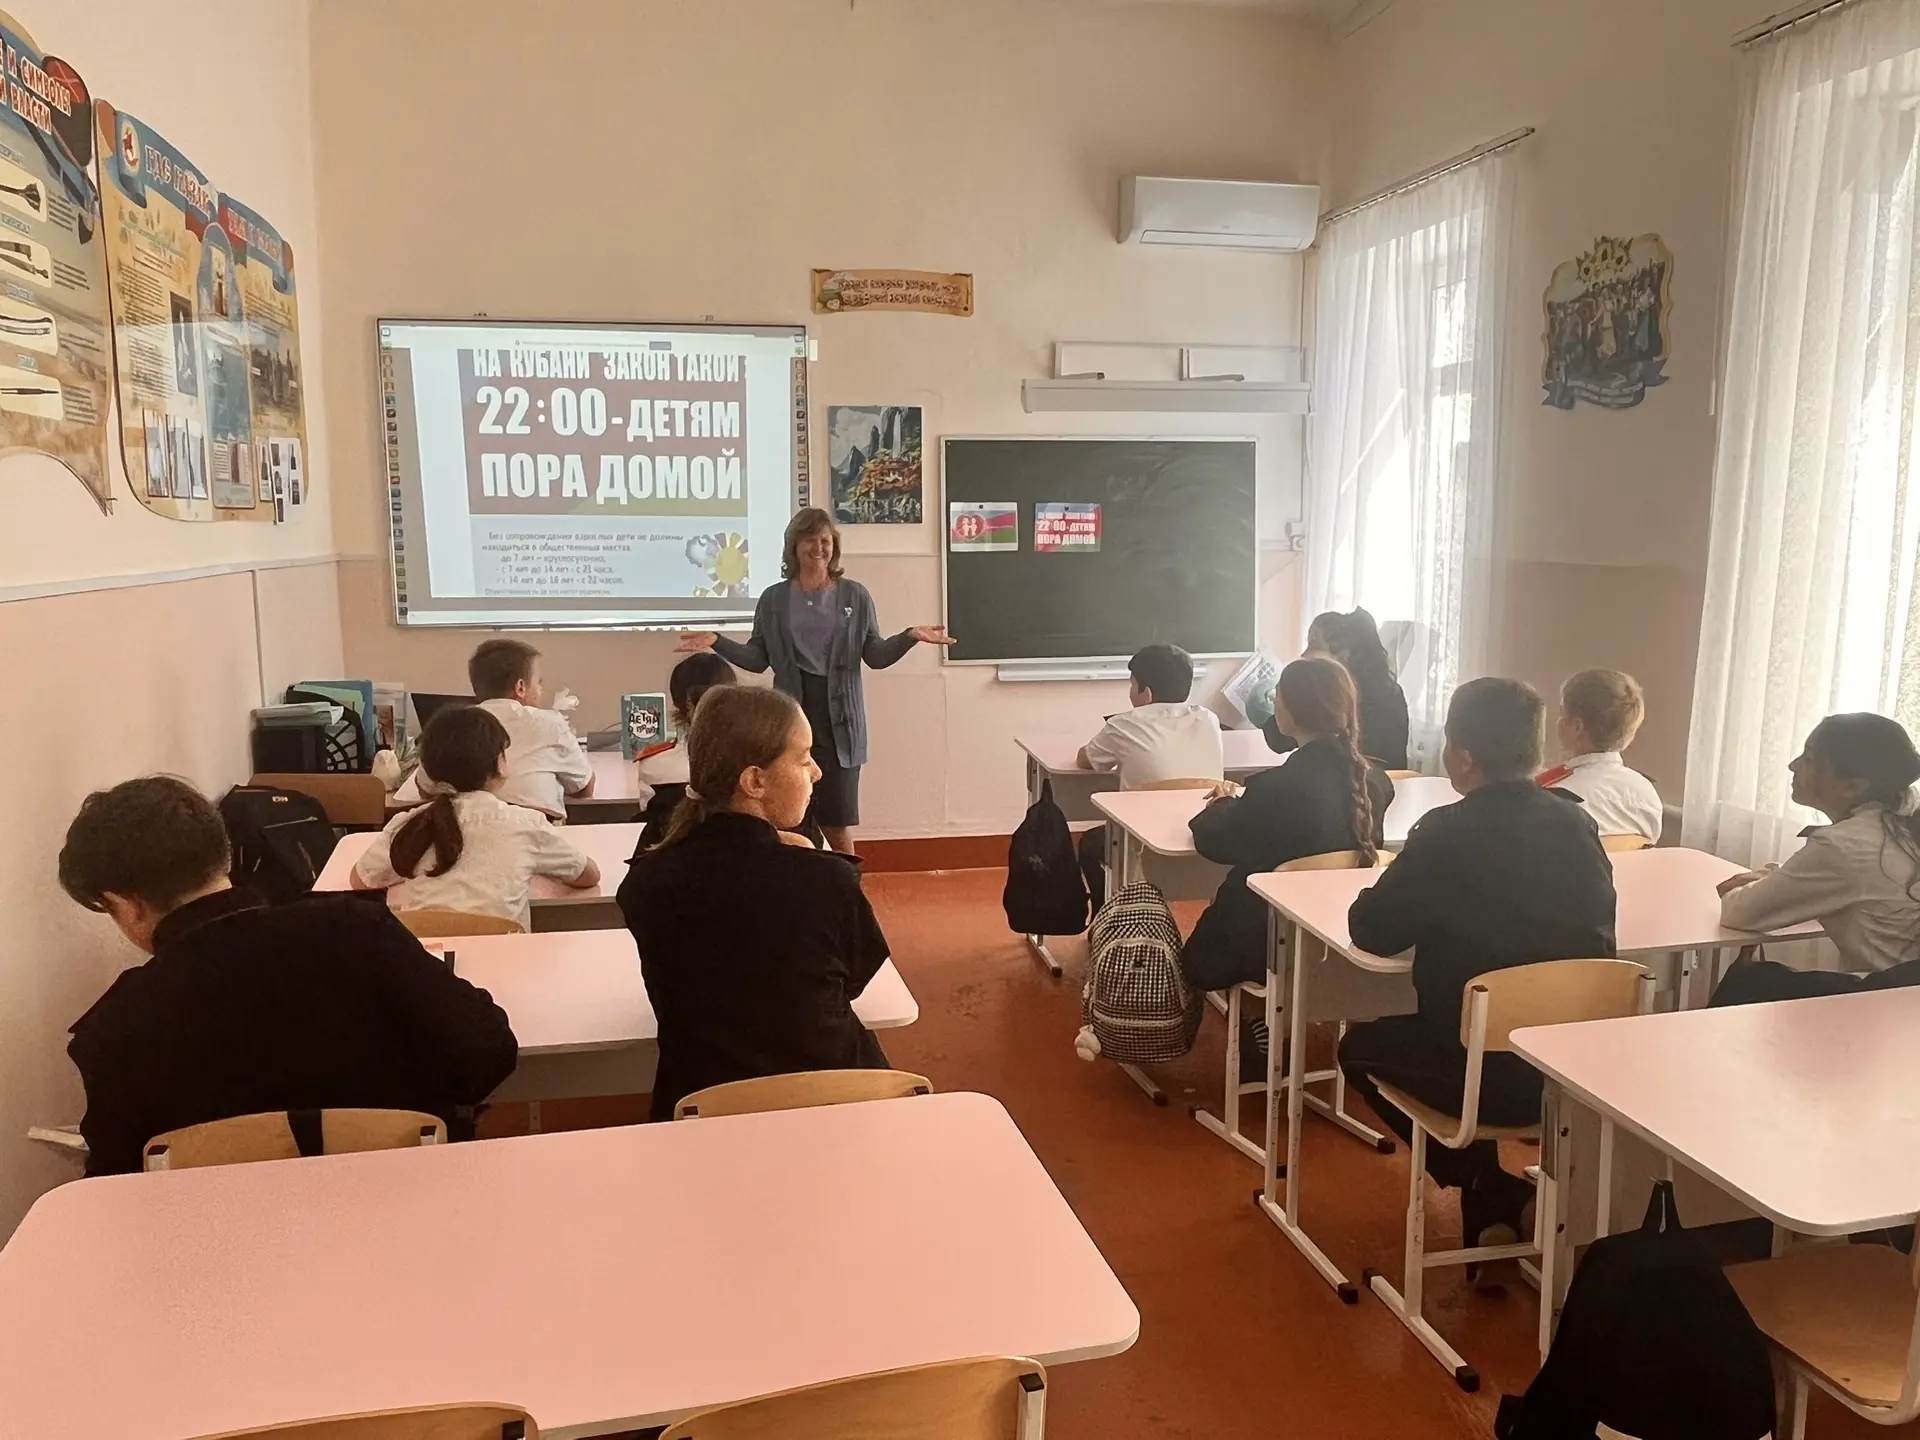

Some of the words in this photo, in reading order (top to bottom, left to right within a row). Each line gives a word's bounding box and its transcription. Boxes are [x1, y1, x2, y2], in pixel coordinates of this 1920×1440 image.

[473, 349, 501, 378] НА
[509, 349, 590, 379] КУБАНИ
[603, 350, 670, 381] ЗАКОН
[481, 453, 588, 498] ПОРА
[596, 447, 741, 505] ДОМОЙ
